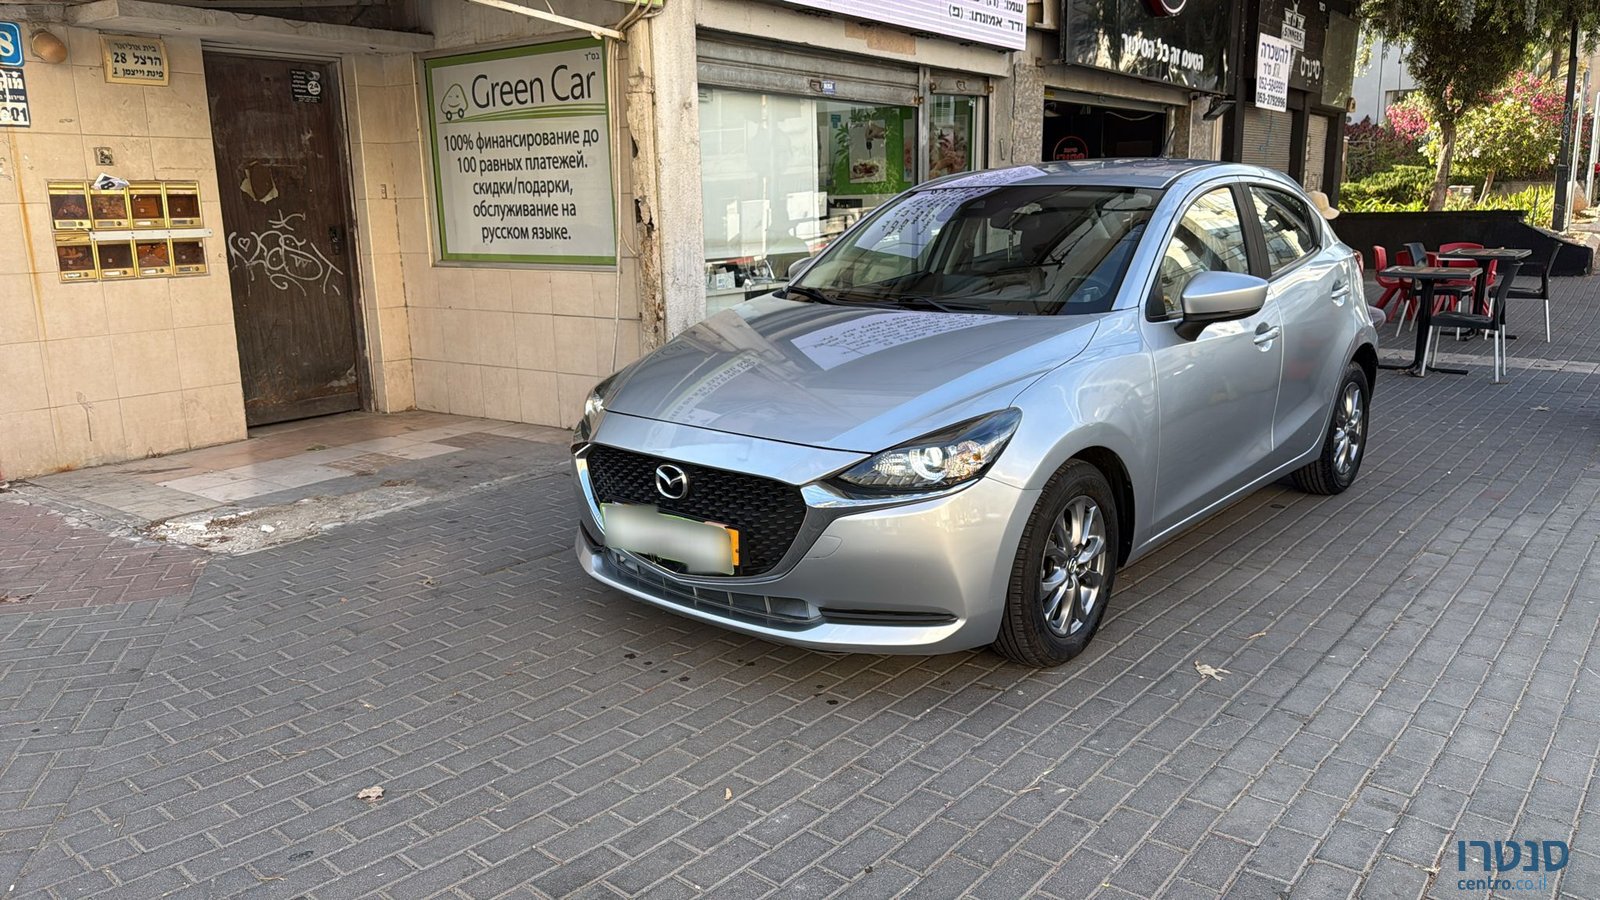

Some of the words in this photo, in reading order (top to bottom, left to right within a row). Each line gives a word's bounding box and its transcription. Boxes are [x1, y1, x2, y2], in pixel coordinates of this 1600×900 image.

[948, 4, 963, 19] (פ)
[1008, 20, 1024, 32] ודר
[142, 44, 157, 52] בית
[1157, 37, 1170, 62] כל
[1170, 46, 1181, 66] זה
[1261, 42, 1289, 64] להשכרה
[113, 52, 128, 64] 28
[132, 52, 162, 66] הרצל
[1181, 49, 1204, 72] הטעם
[113, 67, 118, 75] 1
[122, 68, 145, 77] וייצמן
[146, 69, 164, 78] פינת
[472, 74, 545, 108] Green
[551, 64, 596, 101] Car
[444, 135, 474, 151] 100%
[476, 131, 580, 153] финансирование
[583, 128, 599, 147] до
[457, 157, 477, 173] 100
[479, 157, 523, 176] равных
[525, 151, 588, 170] платежей.
[473, 177, 573, 197] скидки/подарки,
[473, 200, 558, 221] обслуживание
[561, 203, 577, 216] на
[482, 226, 529, 243] русском
[532, 226, 571, 240] языке.
